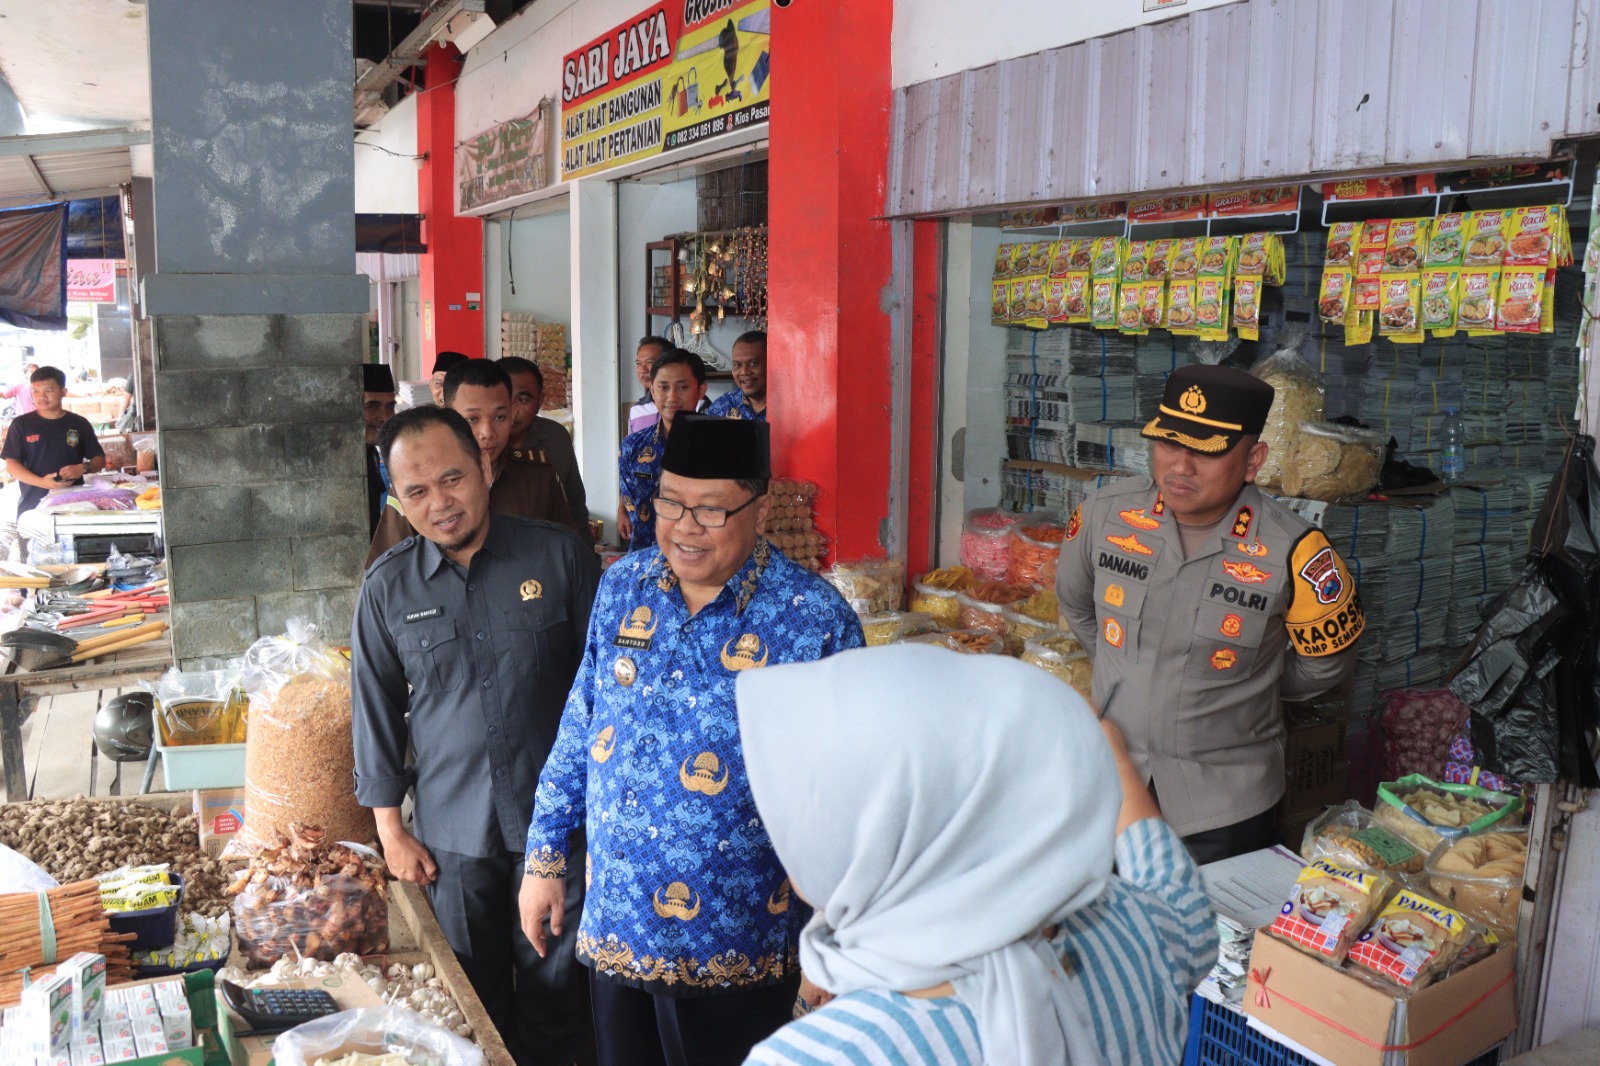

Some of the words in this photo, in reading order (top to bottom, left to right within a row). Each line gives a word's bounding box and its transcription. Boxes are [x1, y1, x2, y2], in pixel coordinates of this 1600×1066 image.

[563, 40, 609, 103] SARI
[613, 10, 671, 81] JAYA
[564, 111, 584, 141] ALAT
[586, 102, 607, 133] ALAT
[608, 77, 661, 125] BANGUNAN
[734, 110, 749, 126] Kios
[564, 143, 584, 174] ALAT
[586, 135, 607, 166] ALAT
[608, 115, 661, 161] PERTANIAN
[1215, 195, 1242, 208] GRATIS
[1437, 217, 1461, 231] Racik
[1476, 215, 1502, 230] Racik
[1520, 212, 1548, 227] Racik
[1392, 224, 1418, 239] Racik
[1426, 278, 1447, 291] Racik
[1465, 278, 1490, 292] Racik
[1508, 278, 1536, 292] Racik
[1099, 552, 1149, 581] DANANG
[1210, 583, 1268, 611] POLRI
[1303, 643, 1328, 655] OMP
[1331, 620, 1363, 649] SEMERU
